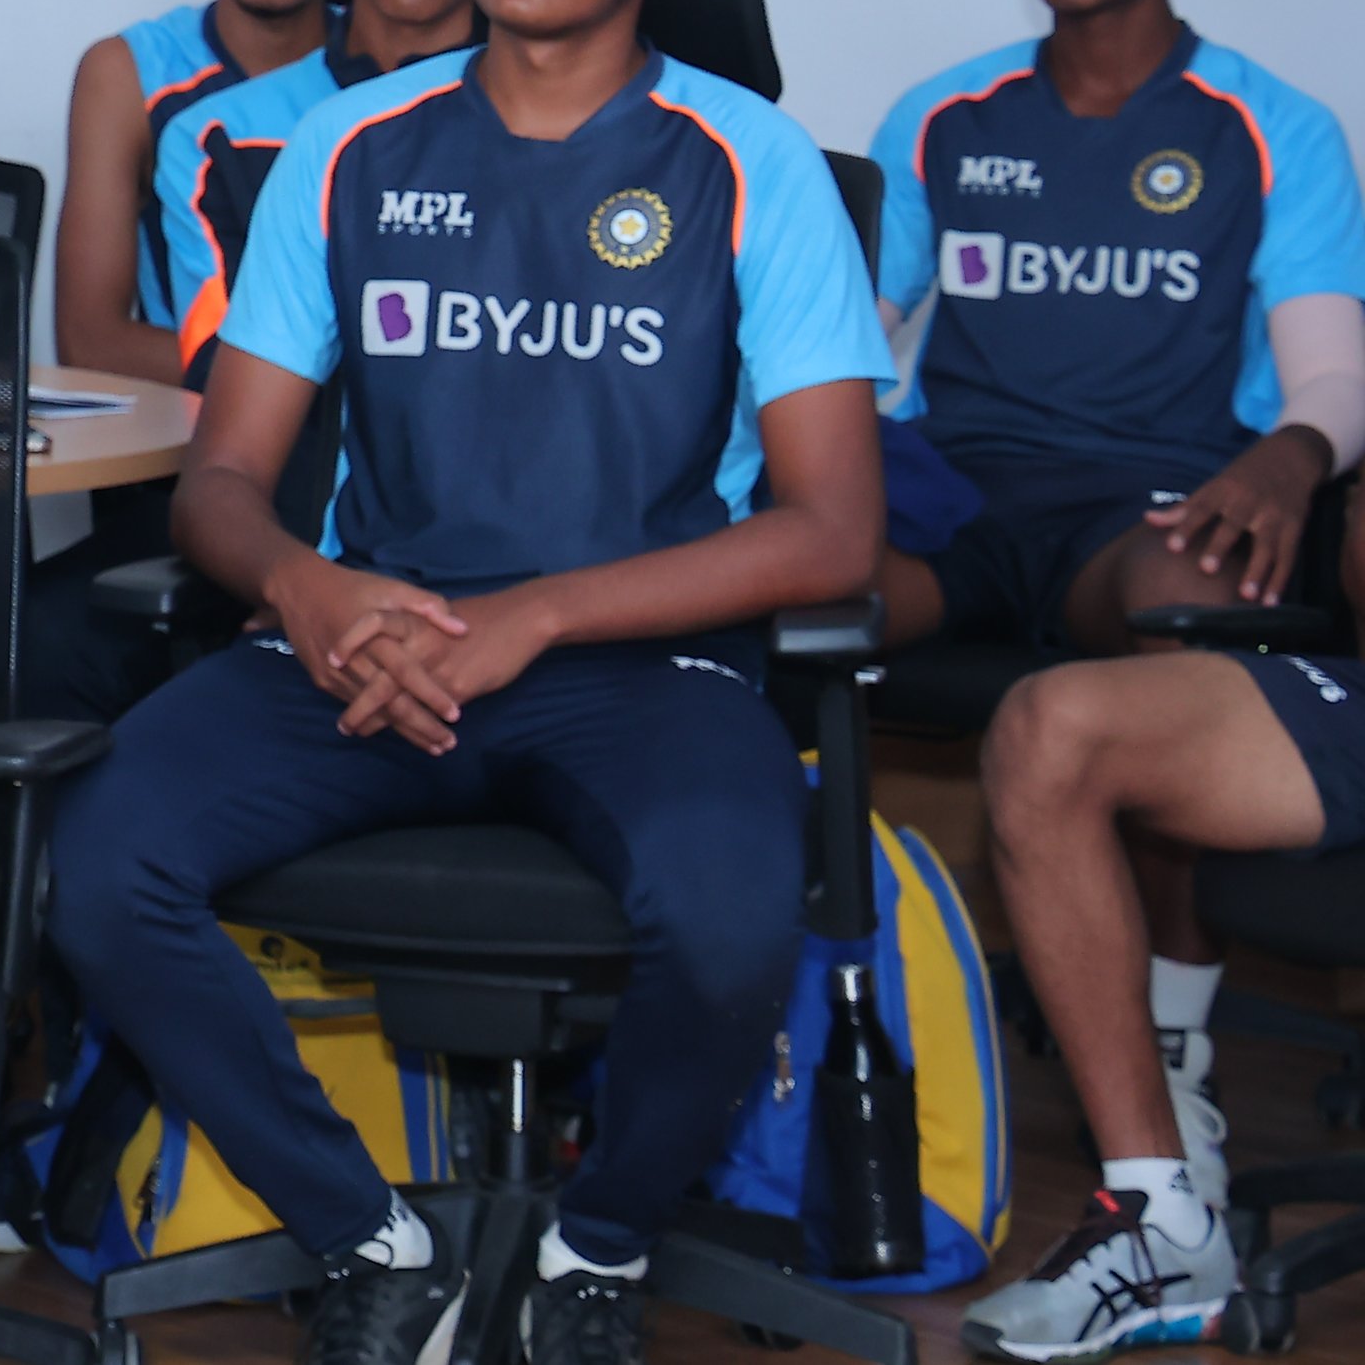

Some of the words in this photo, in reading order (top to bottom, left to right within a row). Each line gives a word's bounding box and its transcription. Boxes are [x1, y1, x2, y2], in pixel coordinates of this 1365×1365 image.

[959, 155, 1043, 191] MPL
[378, 190, 474, 226] MPL
[1008, 241, 1201, 302] BYJU'S
[435, 290, 665, 366] BYJU'S
